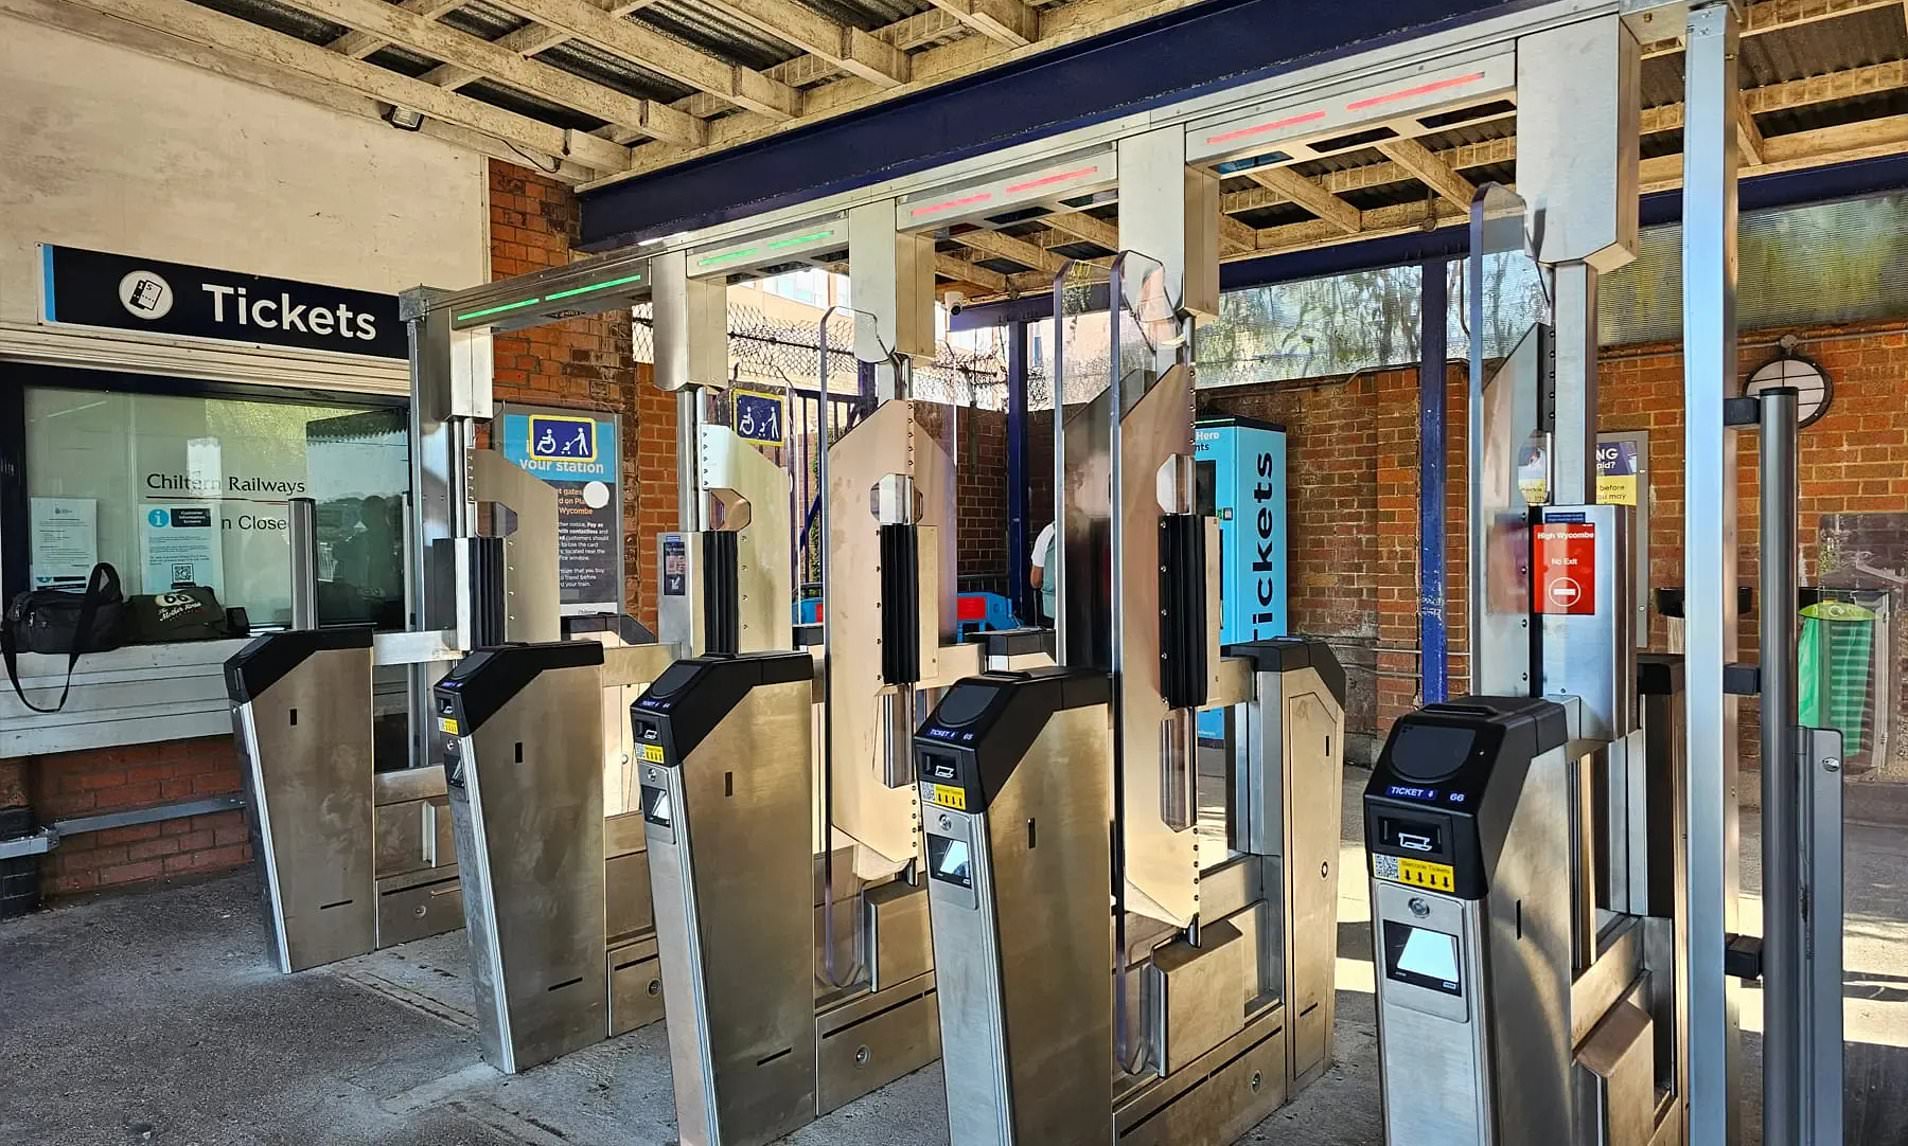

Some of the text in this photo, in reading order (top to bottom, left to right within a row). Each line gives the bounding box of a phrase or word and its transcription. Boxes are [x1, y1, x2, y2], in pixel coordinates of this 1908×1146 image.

[201, 283, 377, 341] Tickets
[1195, 443, 1210, 451] nts
[1596, 448, 1618, 461] NG
[520, 459, 604, 474] your station
[1596, 461, 1616, 469] aid?
[146, 473, 305, 496] Chiltern Railways
[238, 515, 288, 530] Close
[1537, 532, 1594, 540] High Wycombe
[1252, 452, 1273, 641] ickets
[163, 593, 190, 604] 66
[1391, 786, 1465, 802] TICKET 66
